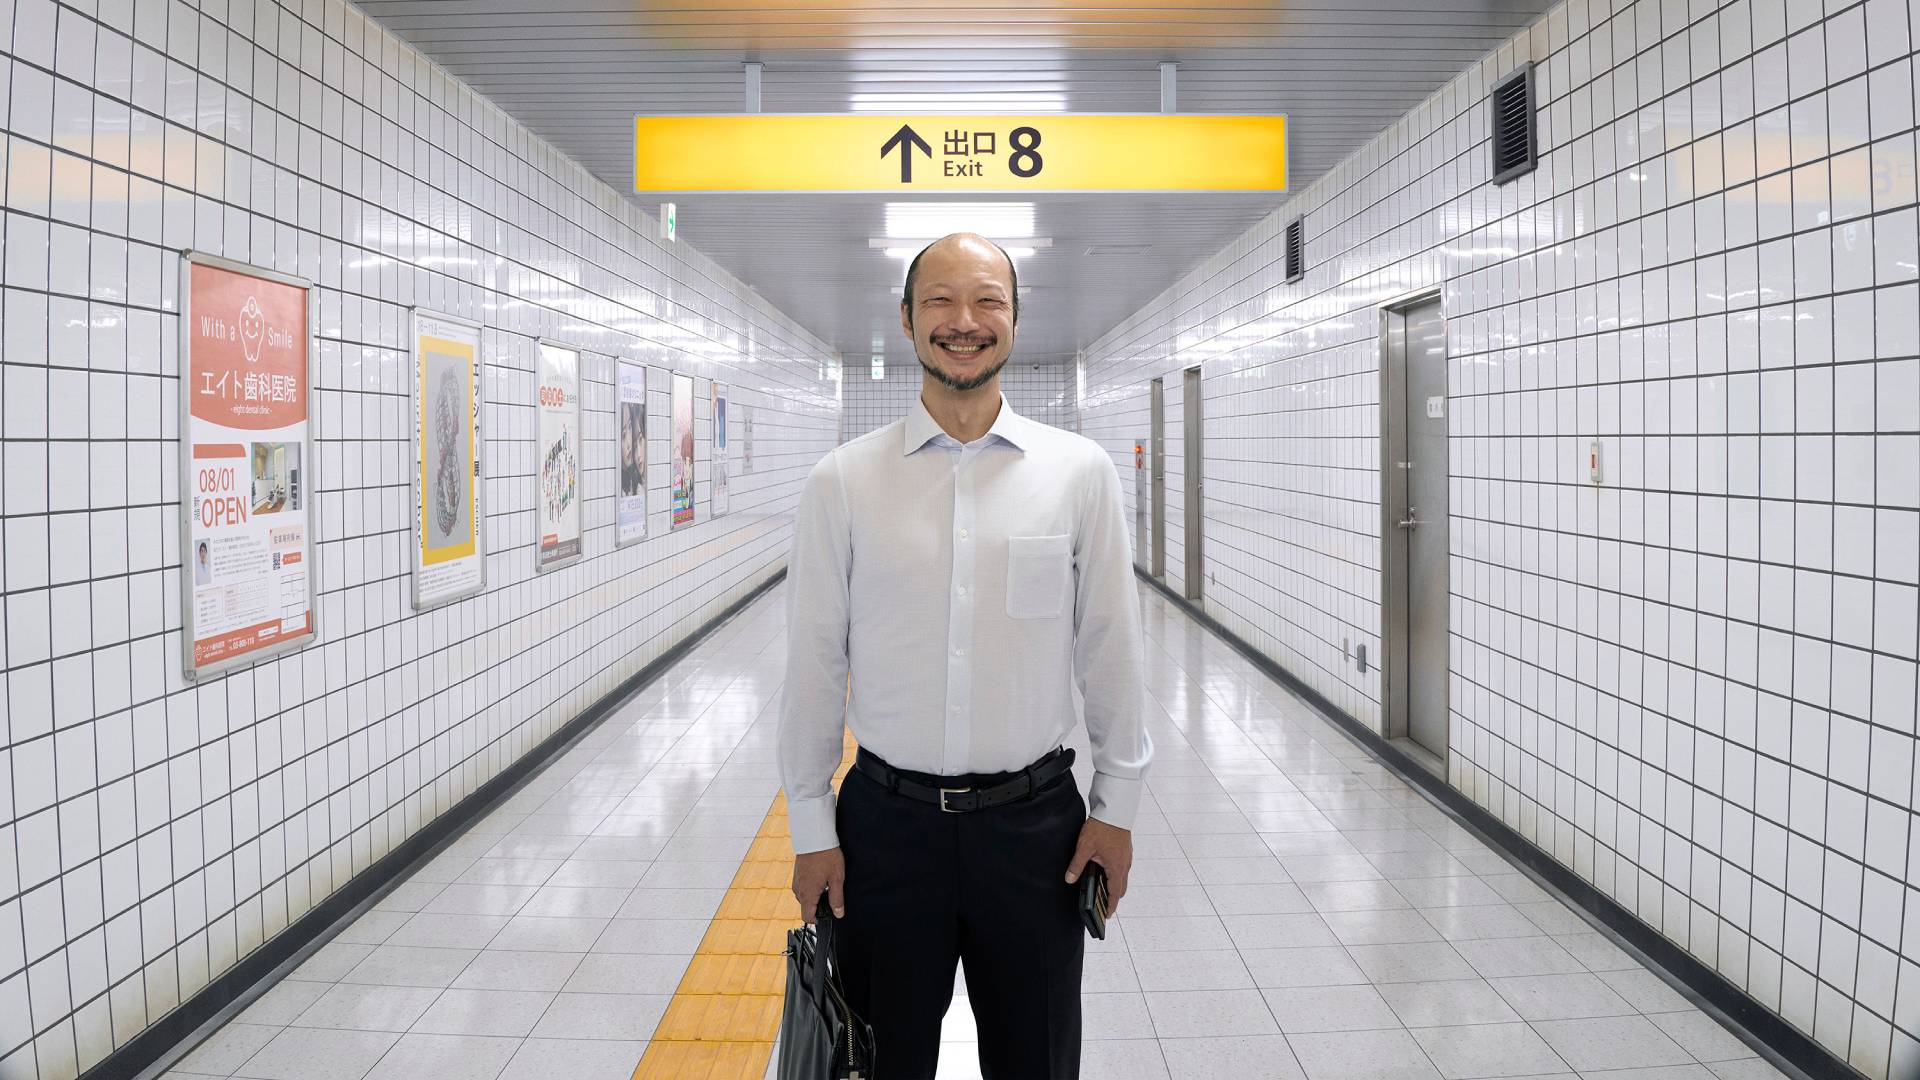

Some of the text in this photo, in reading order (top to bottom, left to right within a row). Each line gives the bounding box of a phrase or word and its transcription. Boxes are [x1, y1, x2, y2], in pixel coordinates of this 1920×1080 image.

[944, 130, 995, 156] 出口
[1009, 127, 1043, 178] 8
[944, 160, 983, 177] Exit
[201, 315, 293, 349] With a Smile
[201, 371, 296, 403] エイト歯科医院
[199, 467, 235, 493] 08/01
[201, 496, 247, 528] OPEN
